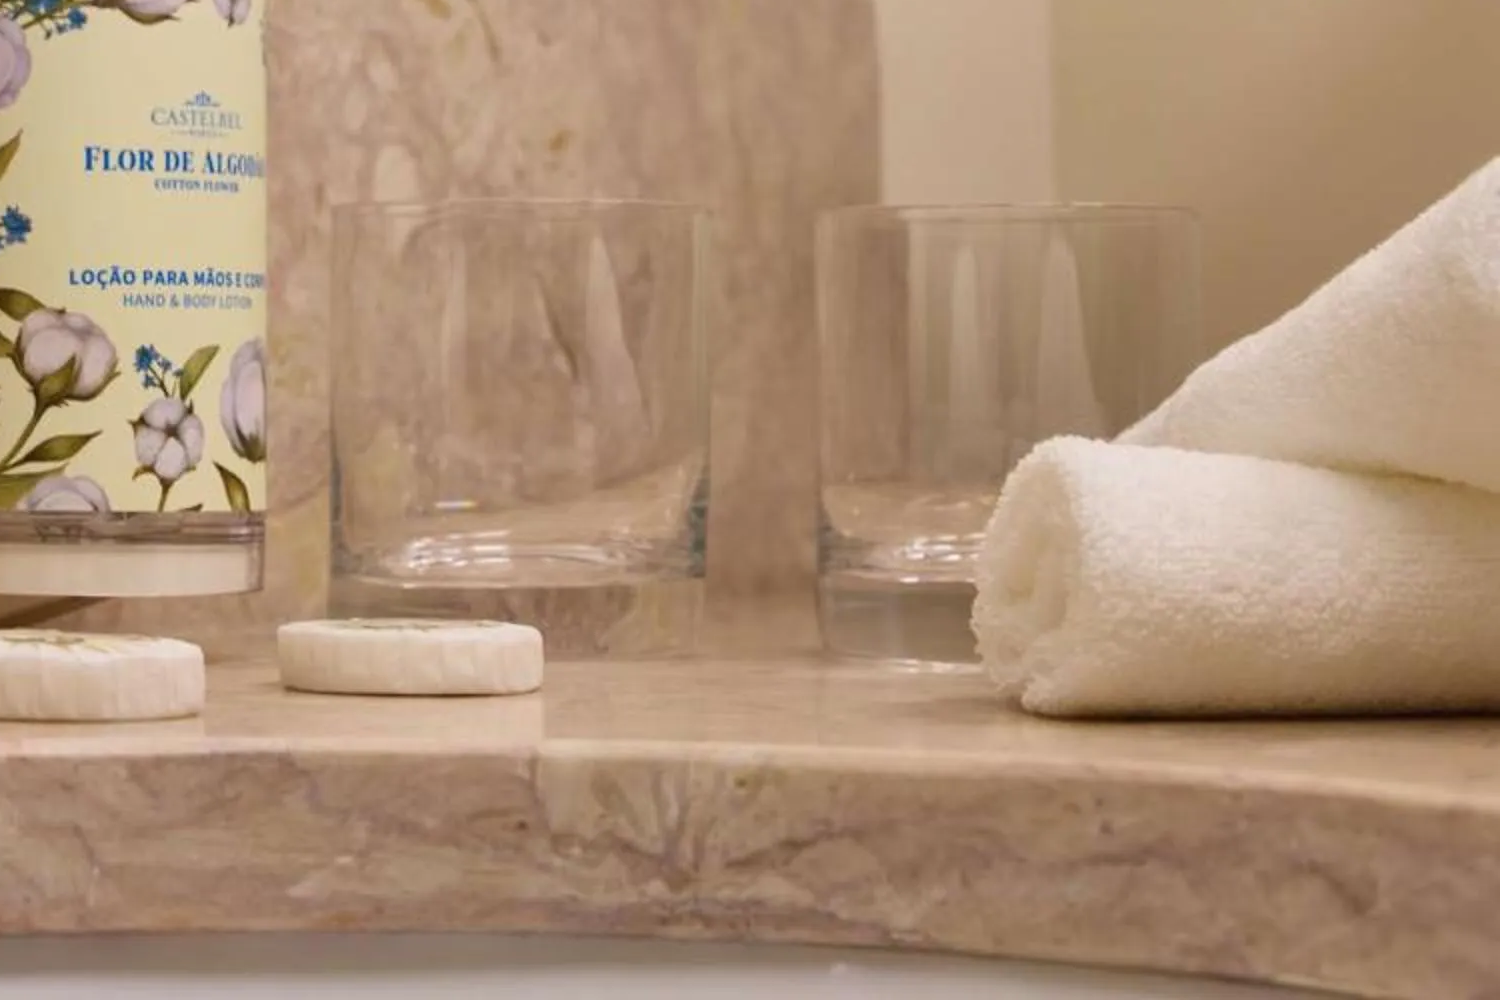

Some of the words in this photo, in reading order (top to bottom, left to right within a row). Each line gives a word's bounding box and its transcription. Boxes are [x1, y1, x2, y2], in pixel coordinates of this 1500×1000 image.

[150, 106, 244, 130] CASTELBEL
[84, 145, 156, 172] FLOR
[164, 150, 195, 173] DE
[68, 265, 136, 290] LOÇÃO
[143, 270, 189, 287] PARA
[193, 267, 234, 288] MÃOS
[235, 272, 242, 288] E
[123, 294, 166, 308] HAND
[169, 294, 179, 308] &
[183, 294, 217, 309] BODY
